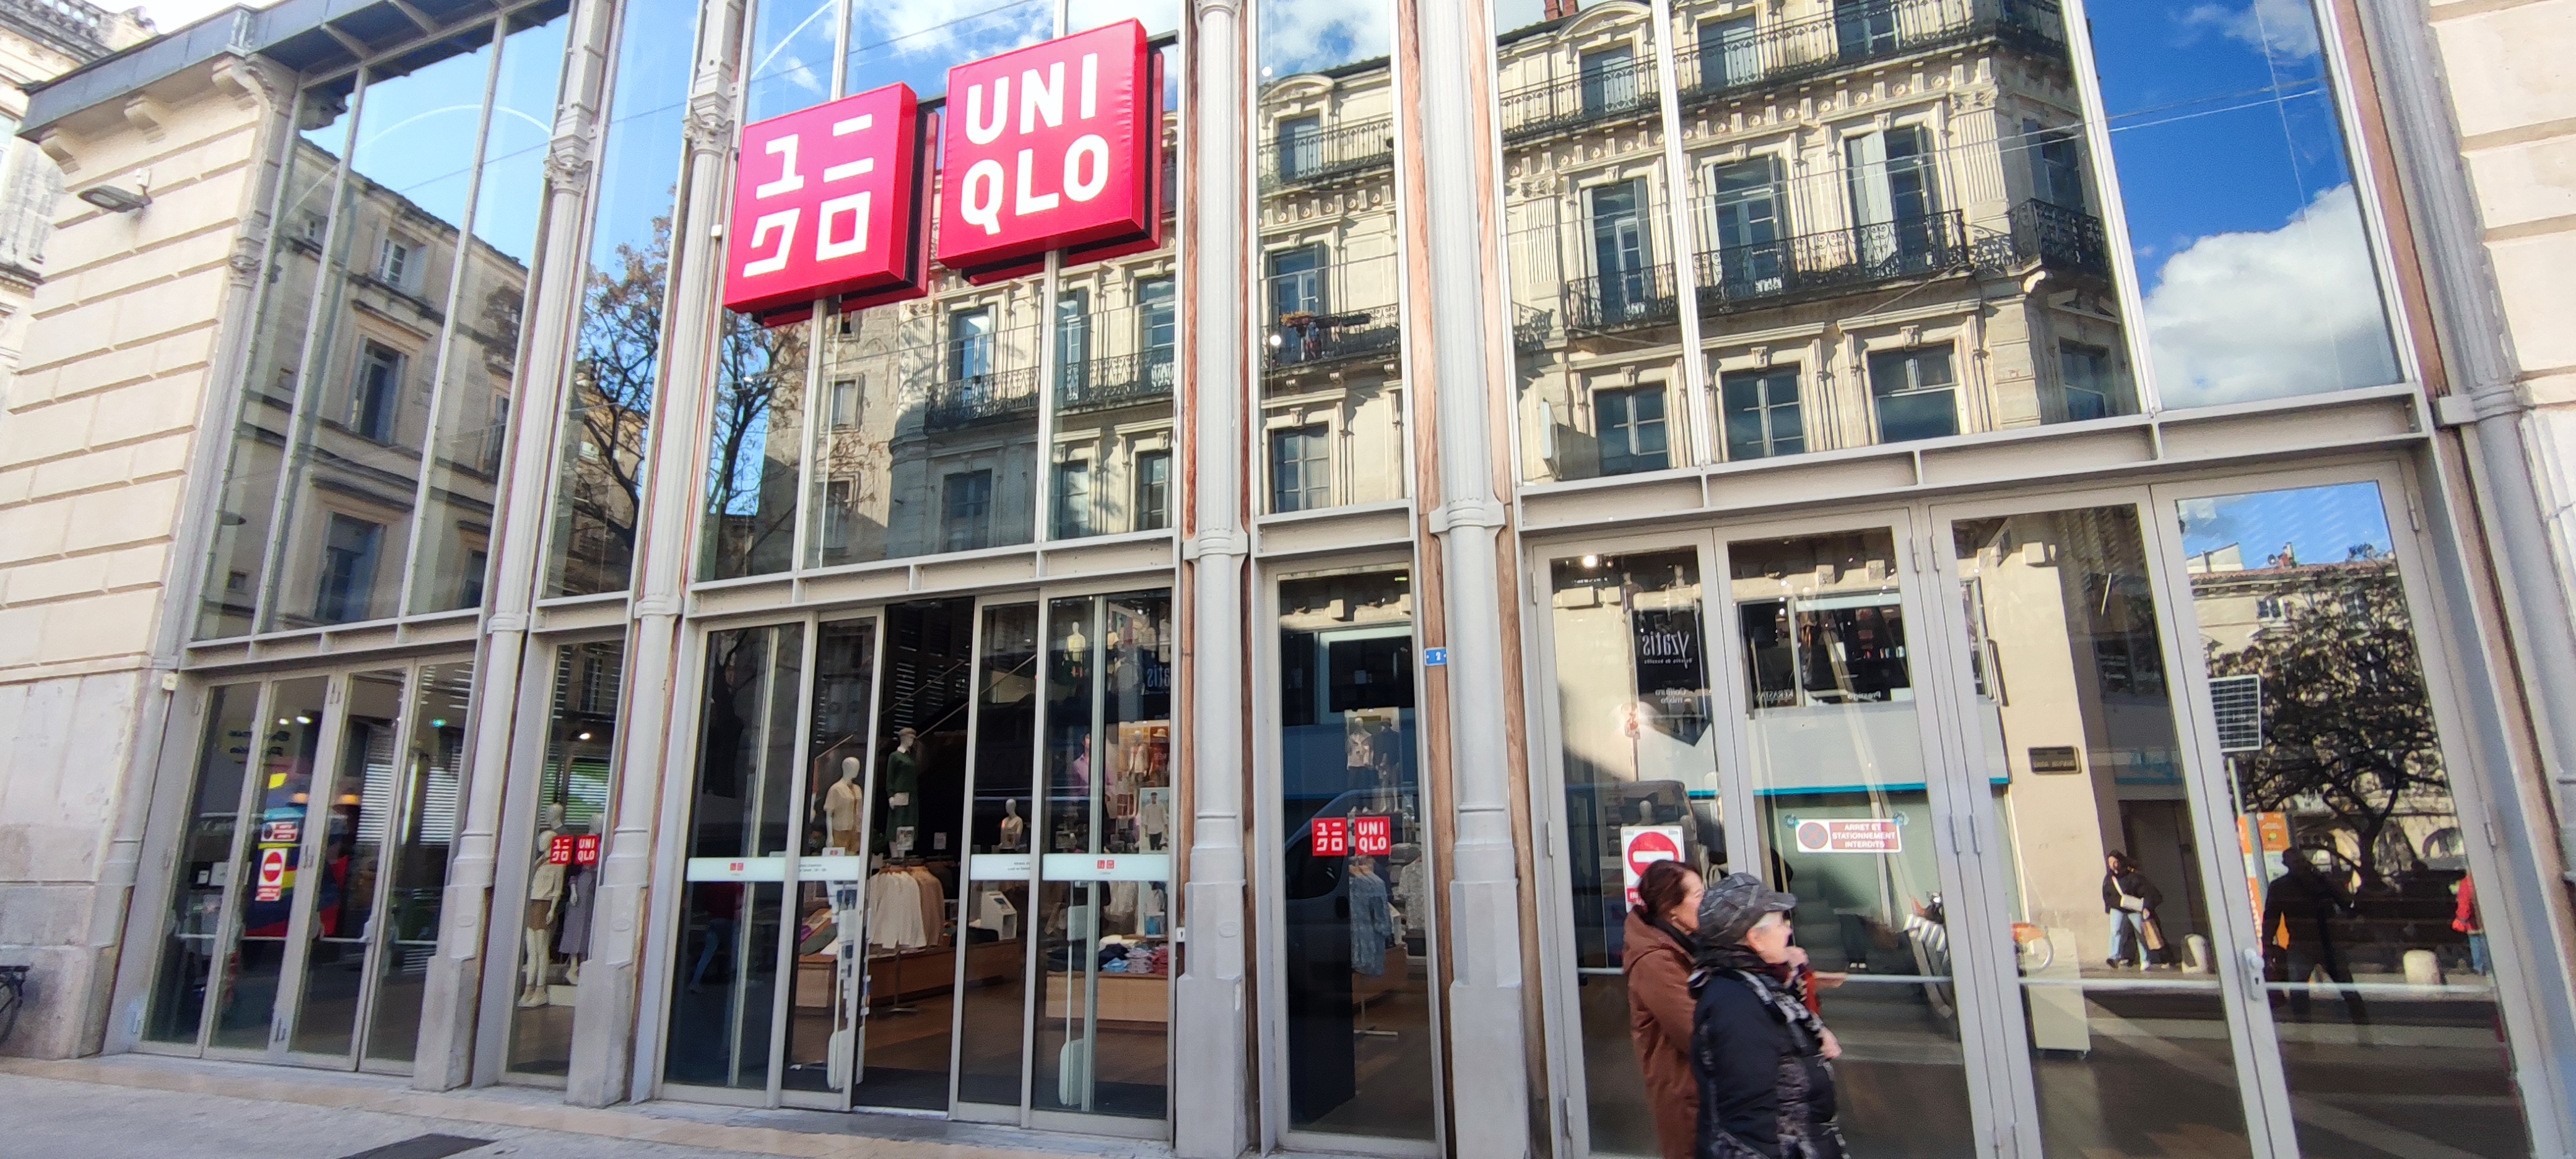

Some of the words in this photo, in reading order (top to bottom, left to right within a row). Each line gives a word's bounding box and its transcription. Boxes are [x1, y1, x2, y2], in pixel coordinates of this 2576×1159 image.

[965, 53, 1098, 145] UNI
[756, 113, 874, 199] ユニ
[960, 134, 1109, 235] QLO
[742, 191, 871, 277] クロ
[1316, 822, 1342, 836] ユニ
[1358, 821, 1384, 835] UNI
[578, 838, 595, 849] UNI
[1359, 836, 1387, 853] QLO
[1845, 840, 1885, 848] INTERDITS
[577, 850, 595, 862] QLO
